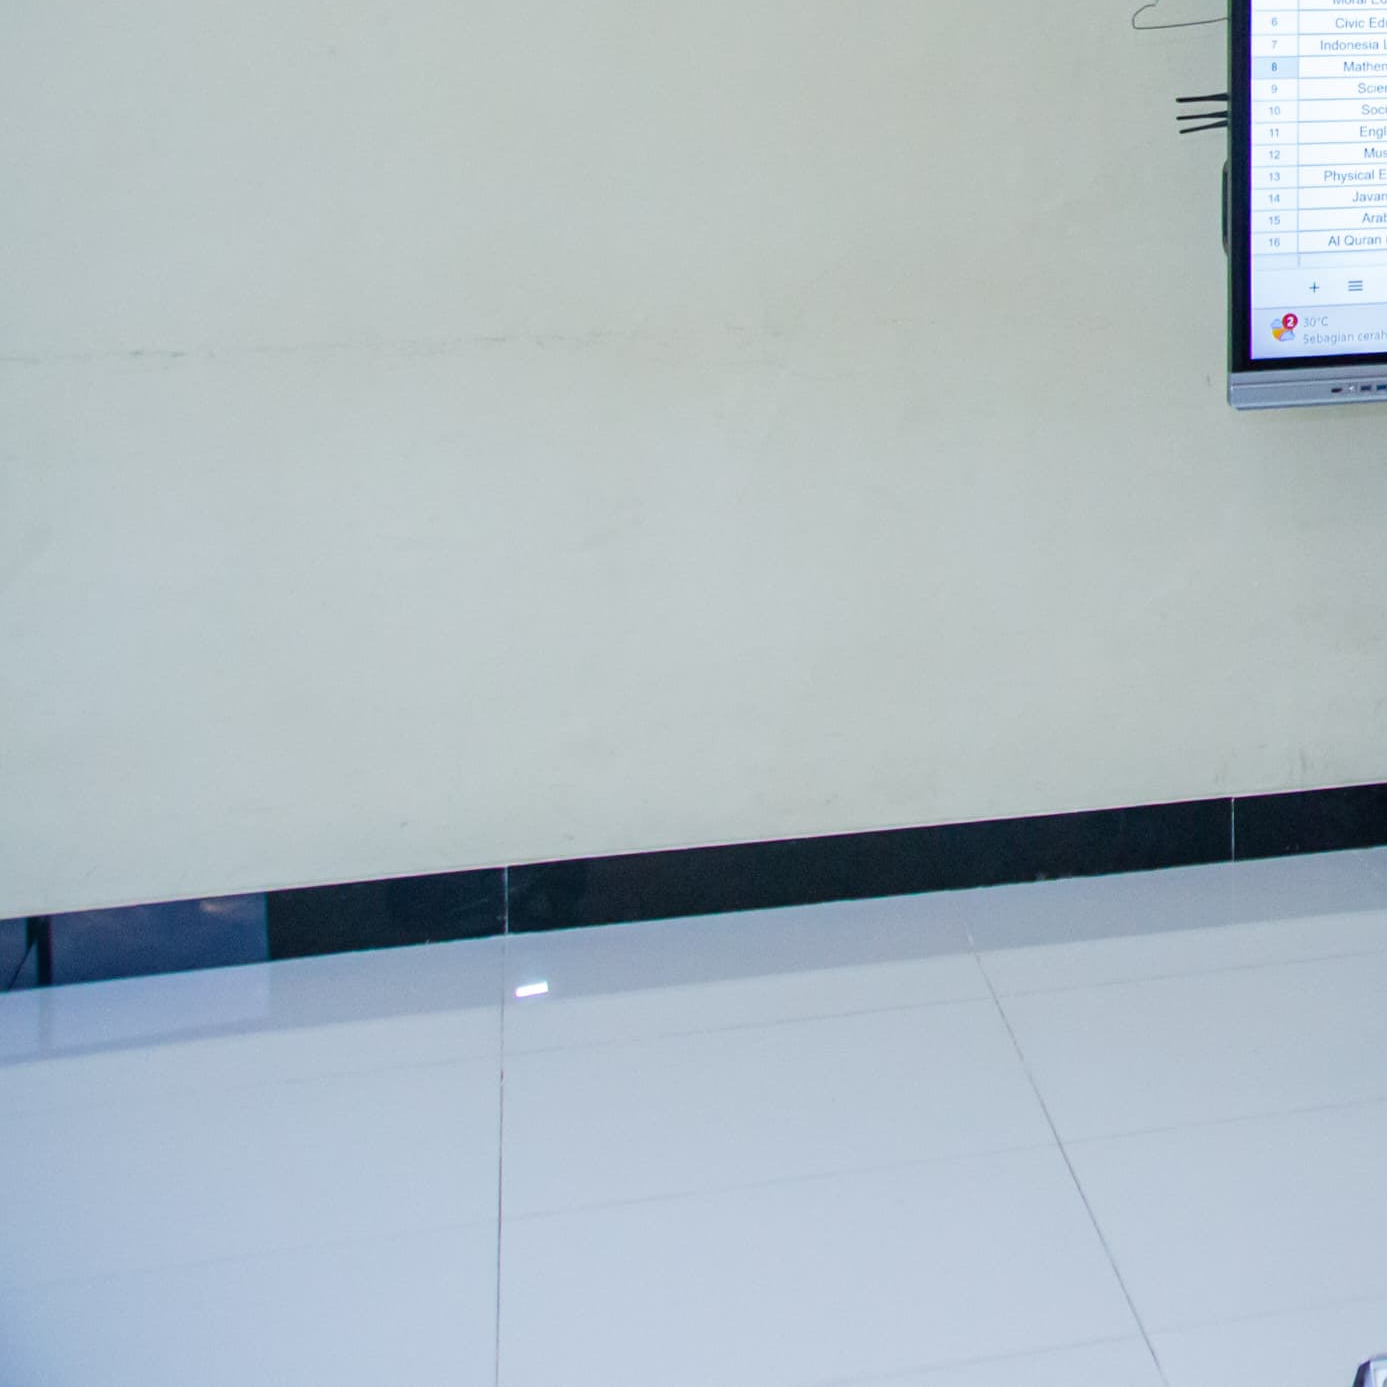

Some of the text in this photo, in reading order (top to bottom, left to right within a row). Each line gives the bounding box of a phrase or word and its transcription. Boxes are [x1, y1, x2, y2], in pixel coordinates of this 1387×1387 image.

[1335, 17, 1365, 29] Civic
[1320, 39, 1379, 51] Indonesia
[1324, 169, 1374, 184] Physical
[1328, 235, 1340, 247] Al
[1344, 234, 1382, 247] Quran
[1303, 330, 1387, 347] Sebagian cerah
